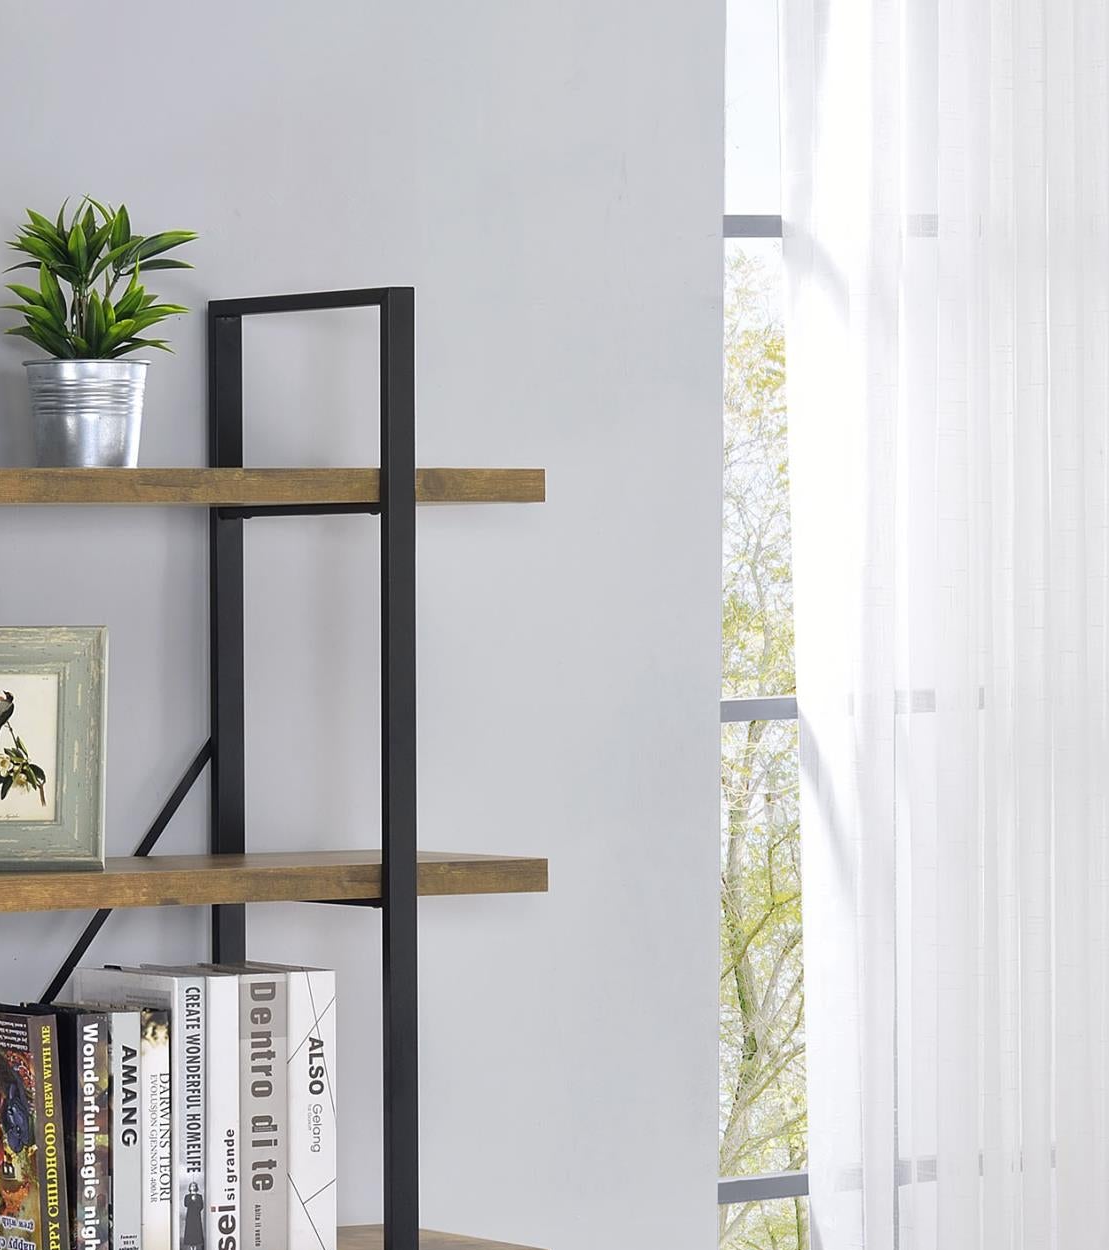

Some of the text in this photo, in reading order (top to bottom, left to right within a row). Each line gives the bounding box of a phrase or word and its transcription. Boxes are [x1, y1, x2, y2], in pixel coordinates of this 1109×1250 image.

[41, 1025, 51, 1044] ME
[42, 1047, 53, 1079] WITH
[185, 987, 201, 1173] CREATE WONDERFUL HOMELIFE
[250, 982, 278, 1191] Dentro di te
[308, 1037, 324, 1095] ALSO
[44, 1081, 54, 1117] GREW
[81, 1023, 100, 1199] Wonderfulmagic
[121, 1045, 138, 1147] AMANG
[149, 1074, 158, 1127] EVOLUSJON
[149, 1129, 158, 1174] GJENNOM
[159, 1073, 171, 1202] DARWINS TEORI
[224, 1129, 237, 1183] grande
[310, 1103, 323, 1153] Gelang
[45, 1122, 58, 1217] CHILDHOOD
